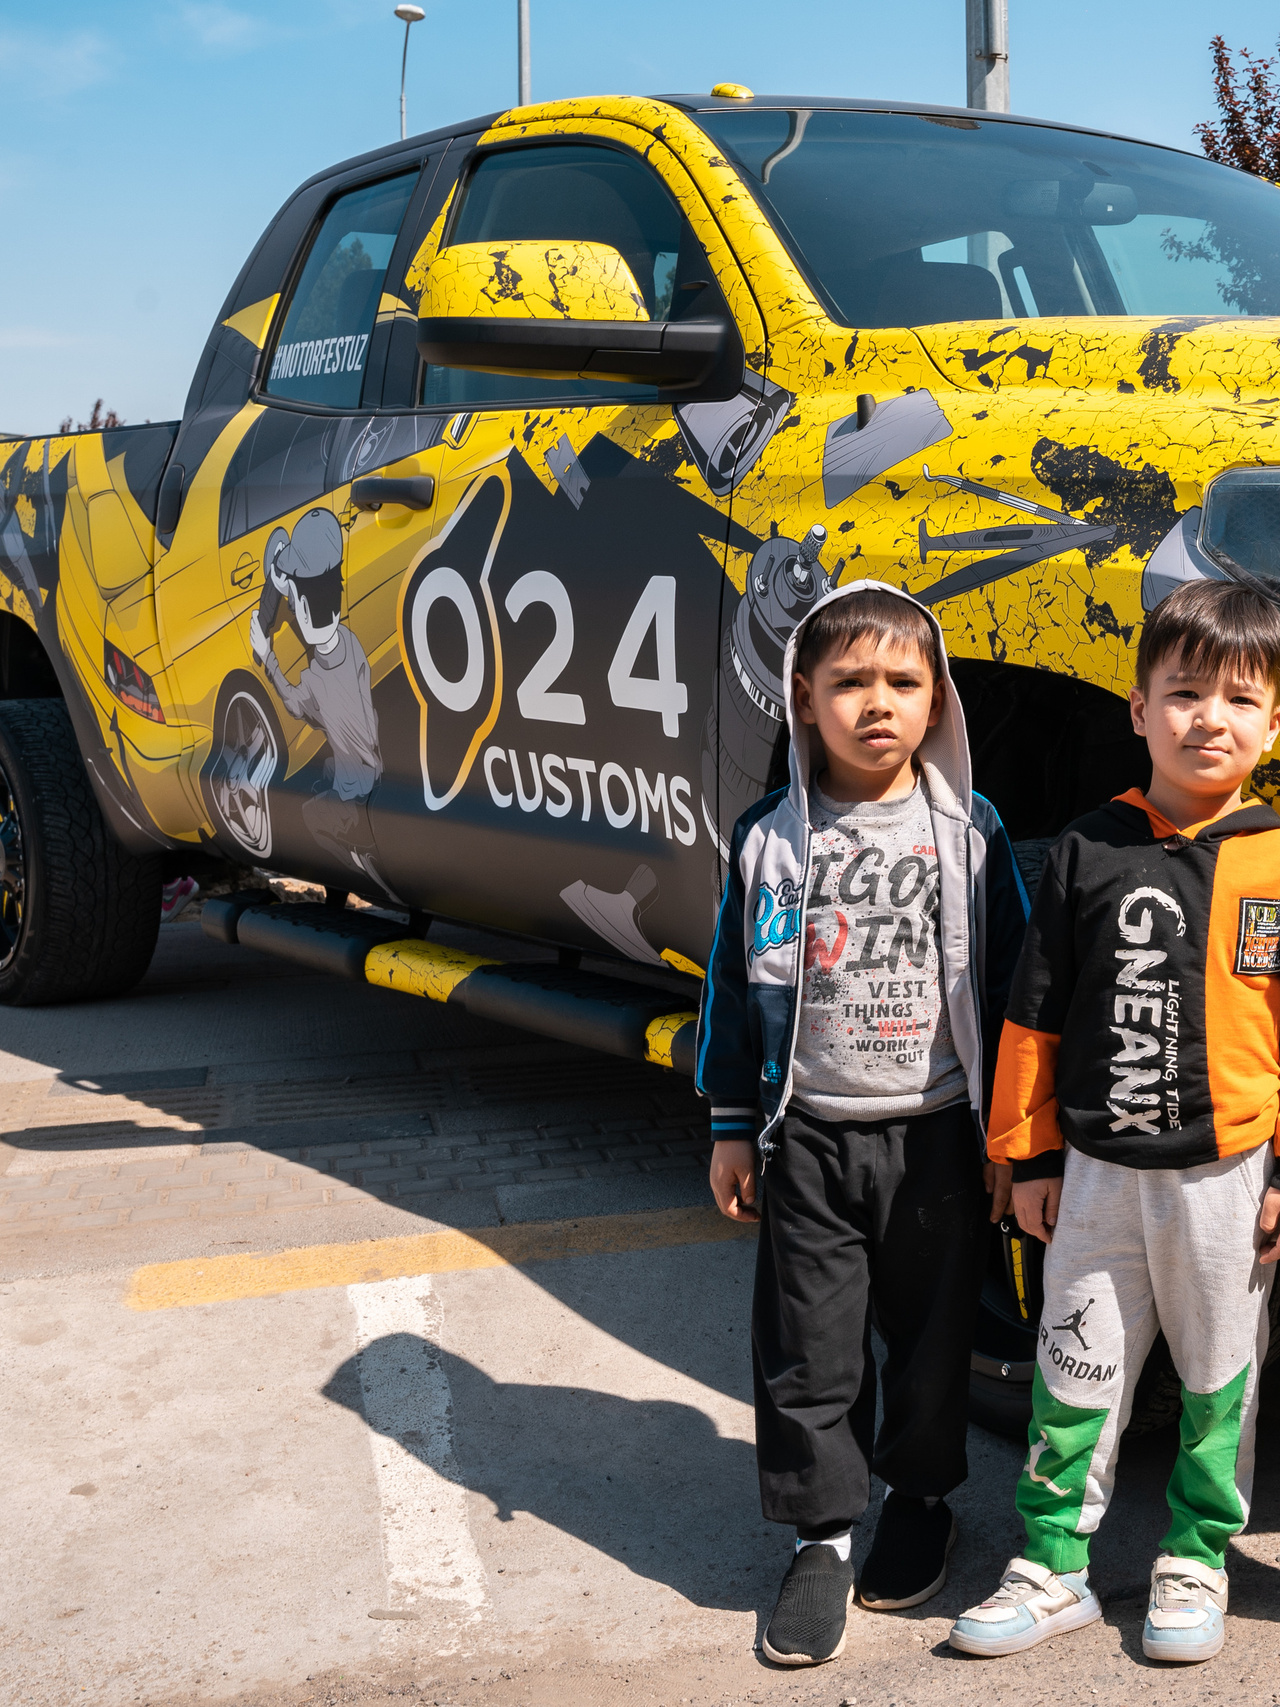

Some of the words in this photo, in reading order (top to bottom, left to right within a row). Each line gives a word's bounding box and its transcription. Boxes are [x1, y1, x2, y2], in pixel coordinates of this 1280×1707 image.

[270, 334, 369, 380] #MOTORFESTUZ
[483, 745, 697, 847] CUSTOMS
[867, 980, 927, 999] VEST
[842, 1002, 914, 1018] THINGS
[877, 1018, 921, 1038] WILL
[855, 1038, 909, 1053] WORK
[895, 1049, 925, 1064] OUT
[1165, 1087, 1182, 1131] TIDE
